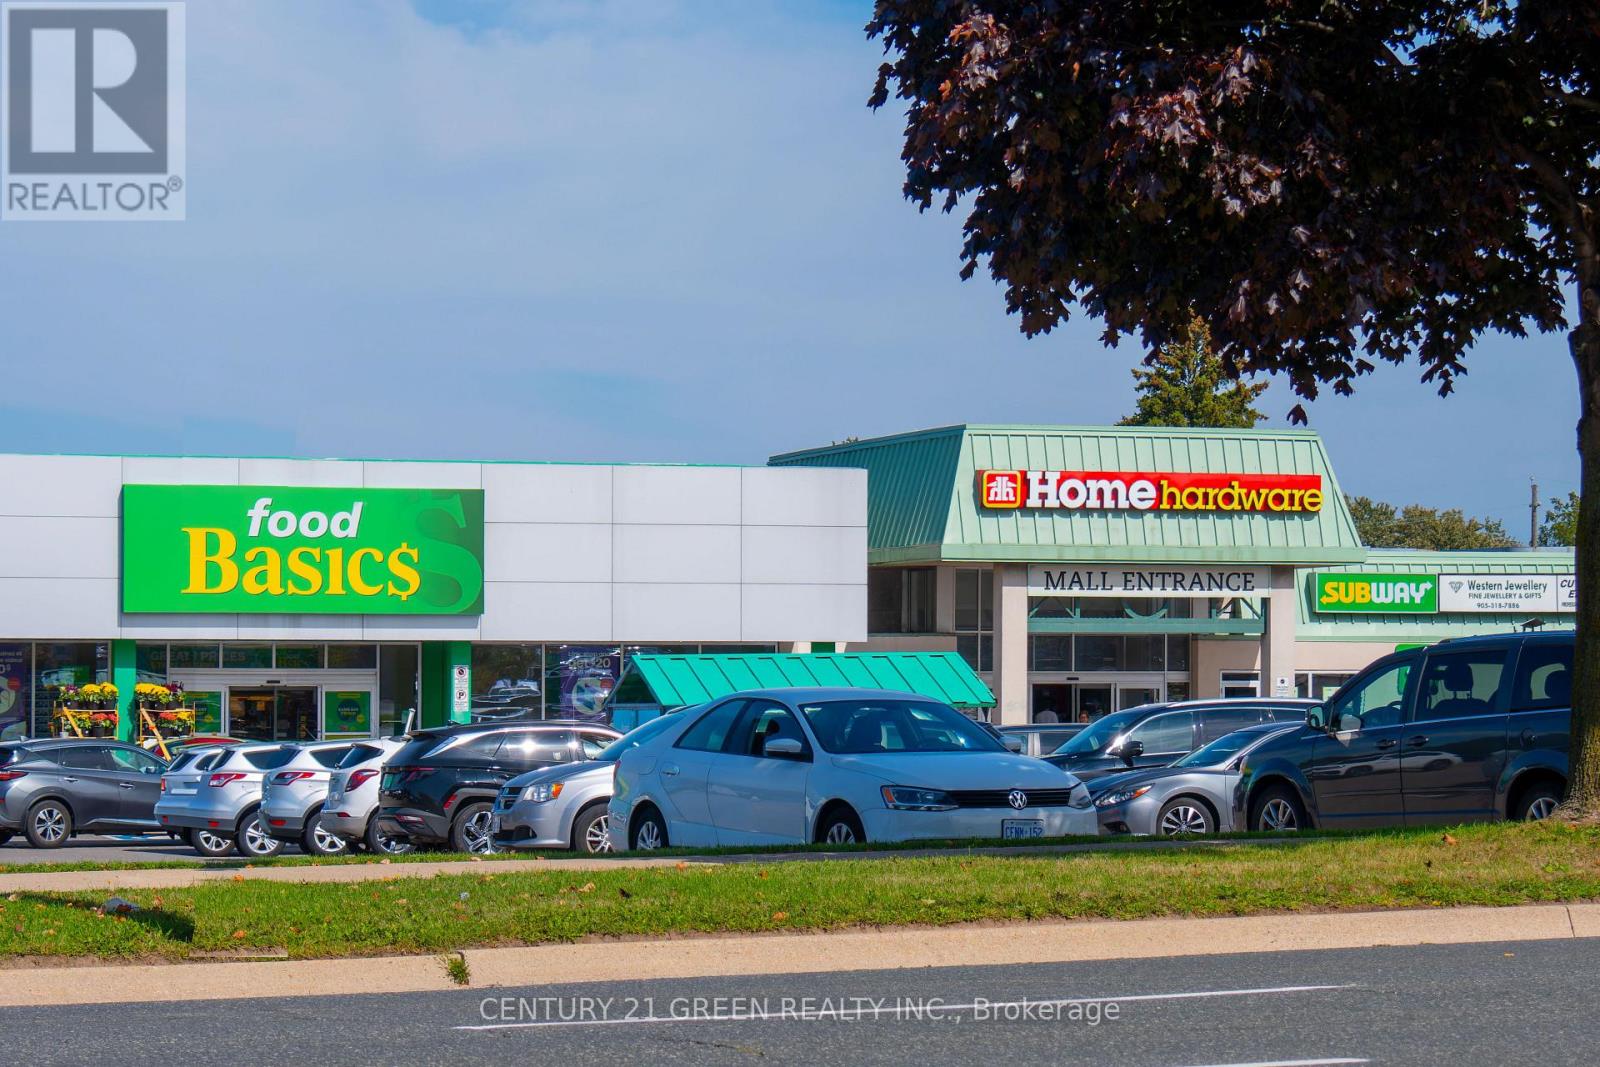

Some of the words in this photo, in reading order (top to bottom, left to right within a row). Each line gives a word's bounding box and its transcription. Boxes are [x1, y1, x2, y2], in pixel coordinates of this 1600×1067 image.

[1026, 470, 1157, 510] Home
[1159, 480, 1324, 513] hardware
[247, 498, 364, 539] food
[1043, 571, 1113, 591] MALL
[1122, 571, 1255, 592] ENTRANCE
[1320, 580, 1433, 605] SUBWAY
[1467, 580, 1503, 591] Western
[1504, 580, 1548, 593] Jewellery
[1560, 579, 1575, 588] CU
